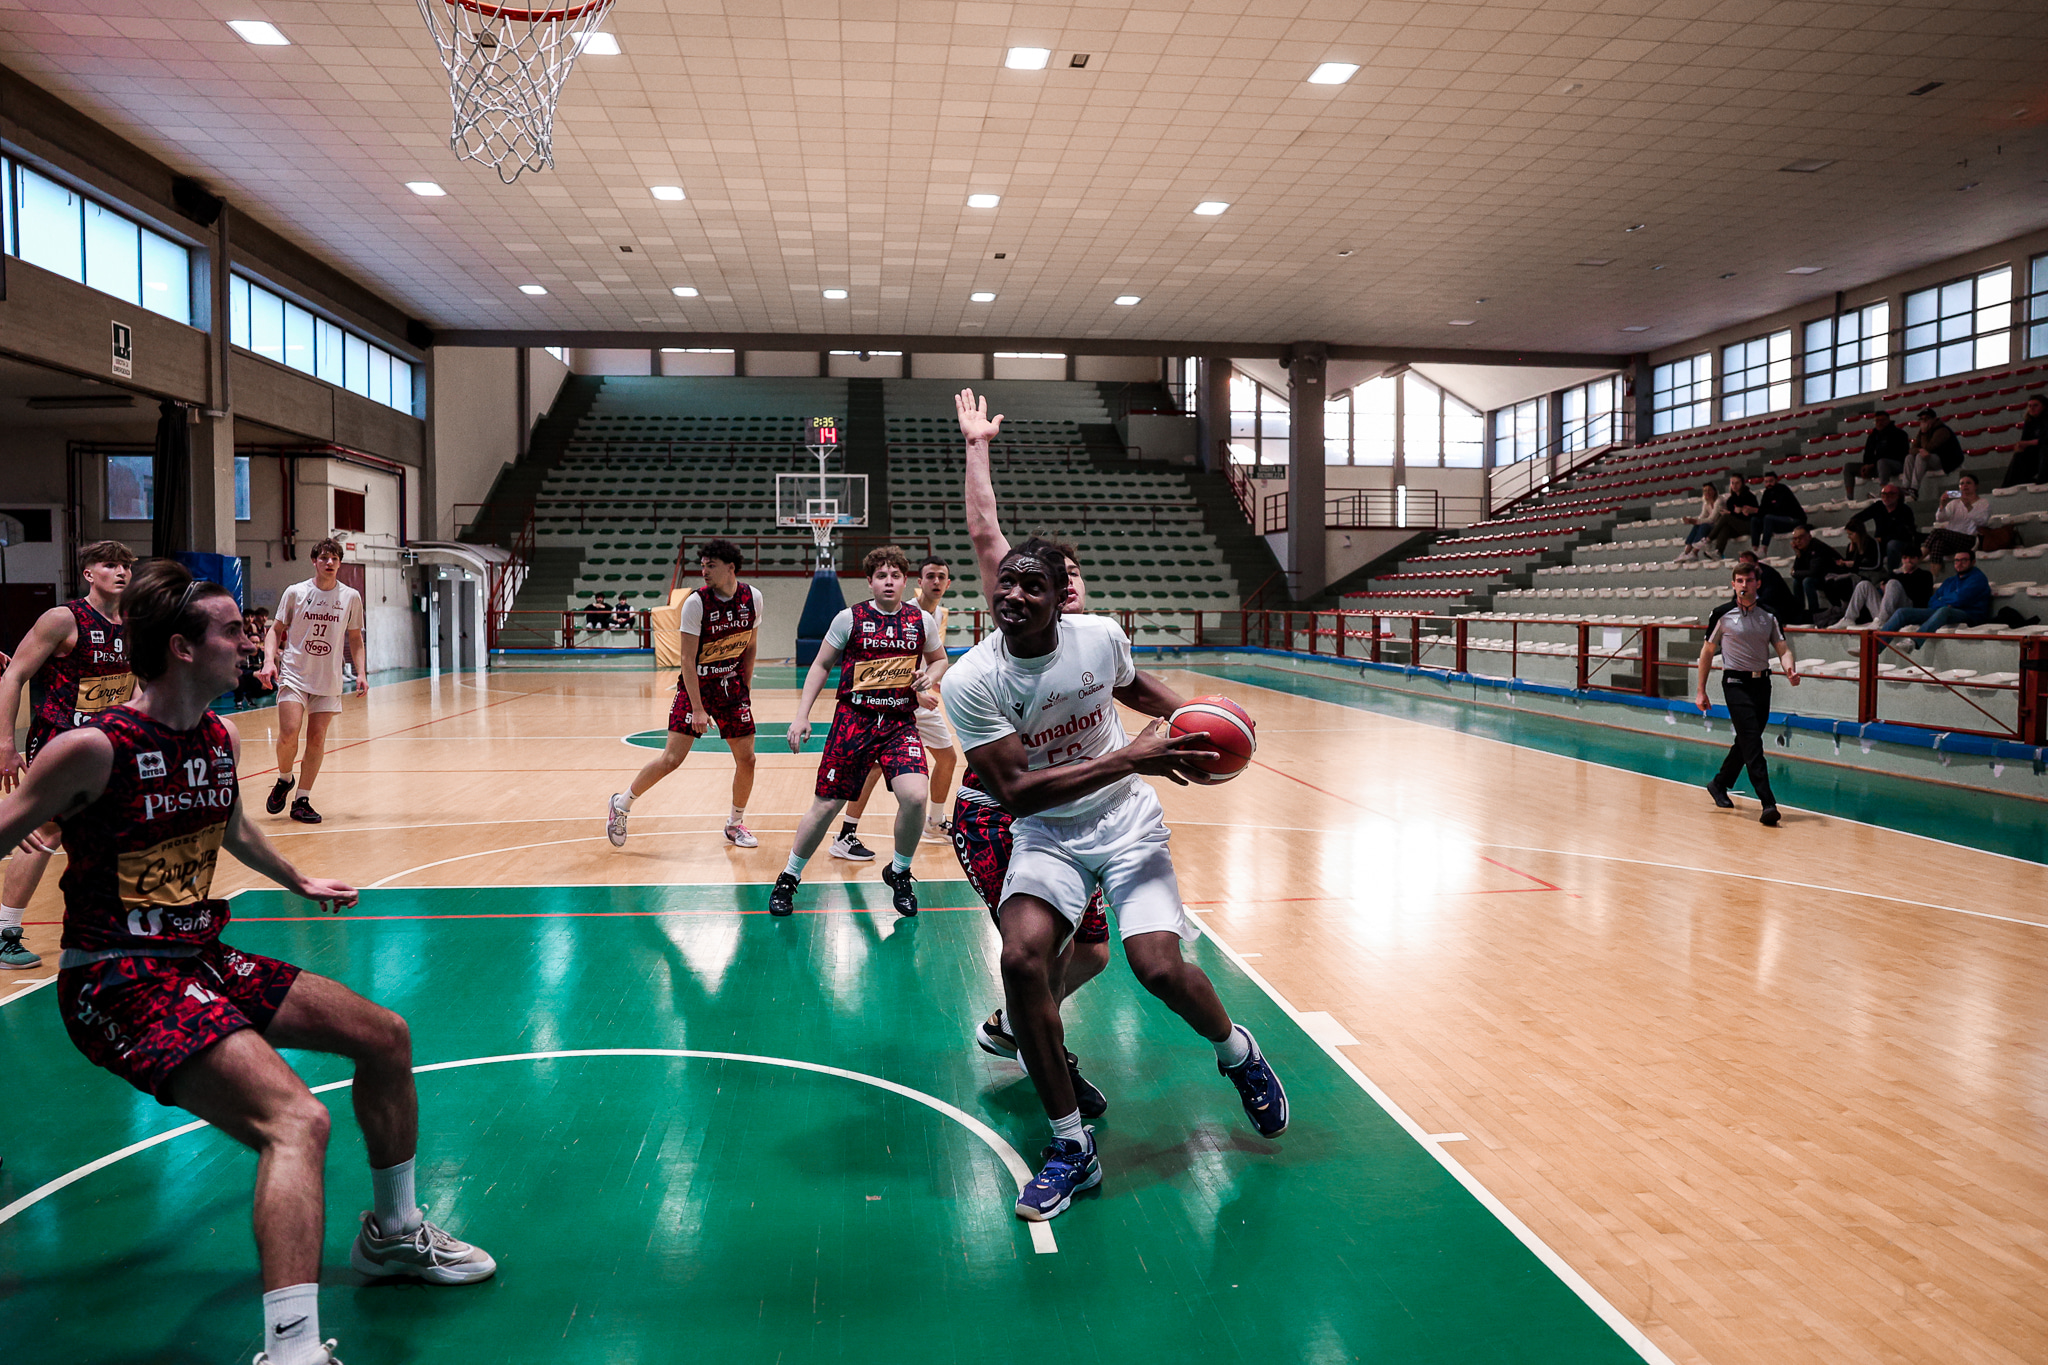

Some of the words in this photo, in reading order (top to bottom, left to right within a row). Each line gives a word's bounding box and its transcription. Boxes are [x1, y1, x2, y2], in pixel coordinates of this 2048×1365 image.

[813, 417, 835, 428] 2:35
[820, 427, 838, 444] 14
[303, 611, 340, 623] Amadori
[726, 610, 733, 622] 5
[312, 623, 328, 637] 37
[712, 619, 749, 634] PESARO
[885, 625, 895, 639] 4
[114, 638, 123, 653] 9
[307, 641, 329, 653] Yoga
[863, 637, 918, 650] PESARO
[93, 650, 129, 664] PESA
[859, 666, 913, 683] Carpegna
[85, 683, 128, 701] Carpe
[1078, 683, 1105, 700] OneTeam
[1021, 703, 1103, 749] Amadori
[183, 757, 210, 788] 12
[826, 768, 836, 782] 4
[144, 786, 233, 820] PESARO
